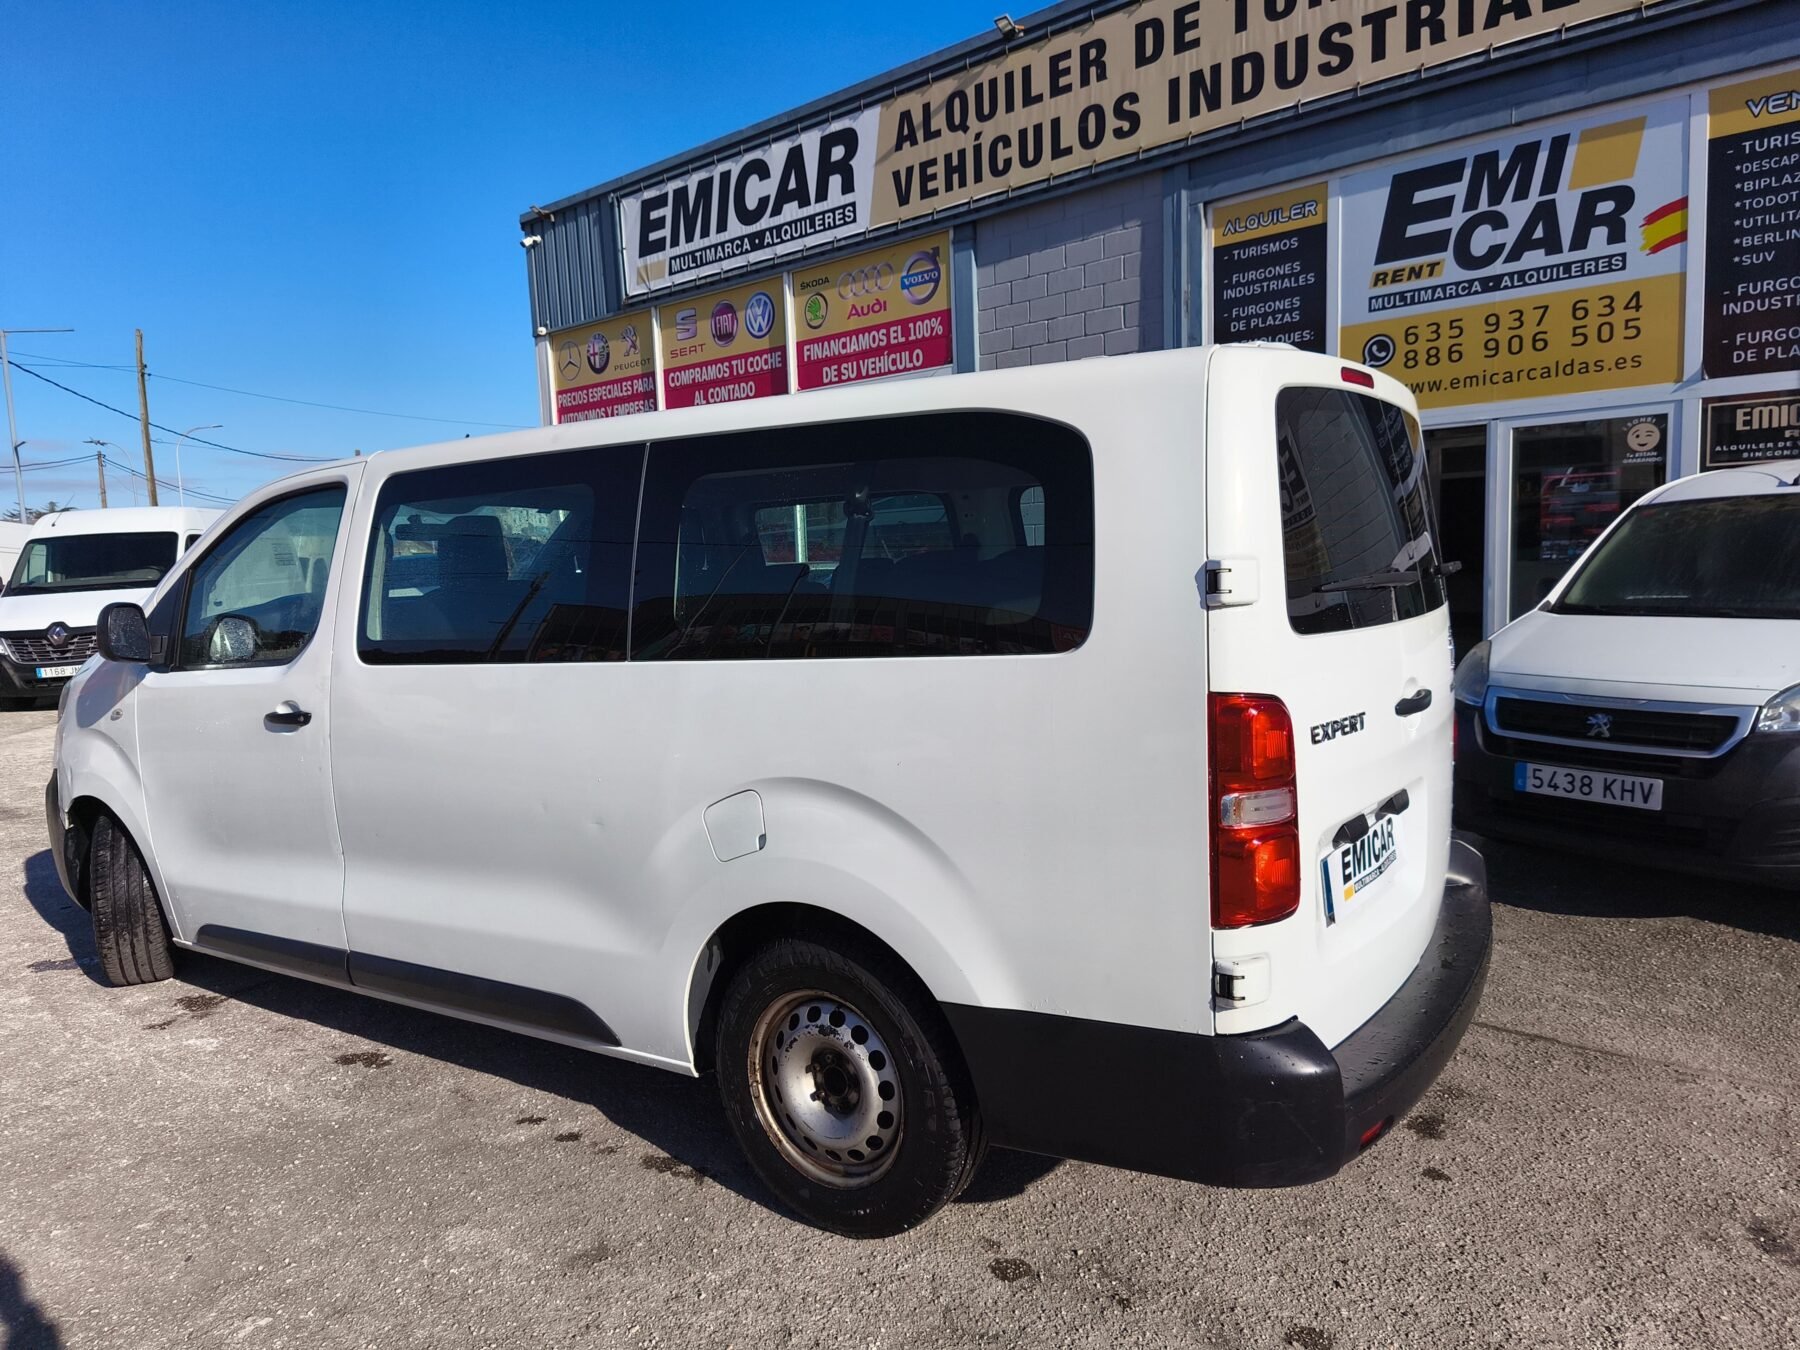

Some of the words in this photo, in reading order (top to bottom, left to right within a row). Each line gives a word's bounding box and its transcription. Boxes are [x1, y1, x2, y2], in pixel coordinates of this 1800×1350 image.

[894, 38, 1108, 152] ALQUILER
[1135, 0, 1201, 70] DE
[892, 91, 1141, 207] VEHÍCULOS
[639, 127, 859, 259] EMICAR
[1374, 133, 1571, 266] EMI
[1222, 200, 1318, 236] ALQUILER
[1453, 184, 1636, 271] CAR
[671, 240, 751, 274] MULTIMARCA
[764, 206, 854, 247] ALQUILERES
[1232, 237, 1299, 261] TURISMOS
[903, 270, 938, 286] VOLVO
[1223, 272, 1316, 300] INDUSTRIALES
[1232, 261, 1301, 285] FURGONES
[1371, 282, 1482, 311] MULTIMARCA
[1500, 256, 1624, 288] ALQUILERES
[1372, 261, 1441, 288] RENT
[847, 298, 887, 320] Audi
[1230, 321, 1247, 332] DE
[1250, 311, 1300, 329] PLAZAS
[1232, 296, 1301, 319] FURGONES
[1404, 318, 1465, 345] 635
[1484, 305, 1550, 334] 937
[1571, 291, 1643, 321] 634
[715, 313, 733, 336] FIAT
[803, 328, 887, 362] FINANCIAMOS
[890, 325, 906, 344] EL
[908, 317, 943, 341] 100%
[1736, 326, 1800, 346] FURGO
[670, 343, 706, 359] SEAT
[1403, 343, 1464, 369] 886
[1483, 331, 1549, 359] 906
[1570, 317, 1642, 347] 505
[1732, 349, 1757, 364] DE
[614, 358, 651, 372] PEUGEOT
[669, 362, 730, 388] COMPRAMOS
[731, 359, 745, 376] TU
[747, 352, 782, 373] COCHE
[822, 365, 838, 384] DE
[841, 360, 857, 380] SU
[859, 349, 924, 377] VEHÍCULO
[1405, 353, 1643, 394] ww.emicarcaldas.es
[558, 391, 588, 408] PRECIOS
[589, 380, 633, 402] ESPECIALES
[633, 376, 655, 395] PARA
[606, 405, 613, 418] Y
[613, 399, 655, 417] EMPRESAS
[694, 390, 706, 406] AL
[708, 381, 756, 403] CONTADO
[1714, 442, 1774, 451] ALQUILER
[1310, 711, 1366, 745] EXPERT
[1531, 768, 1593, 796] 5438
[1602, 777, 1654, 804] KHV
[1341, 816, 1395, 886] EMICAR
